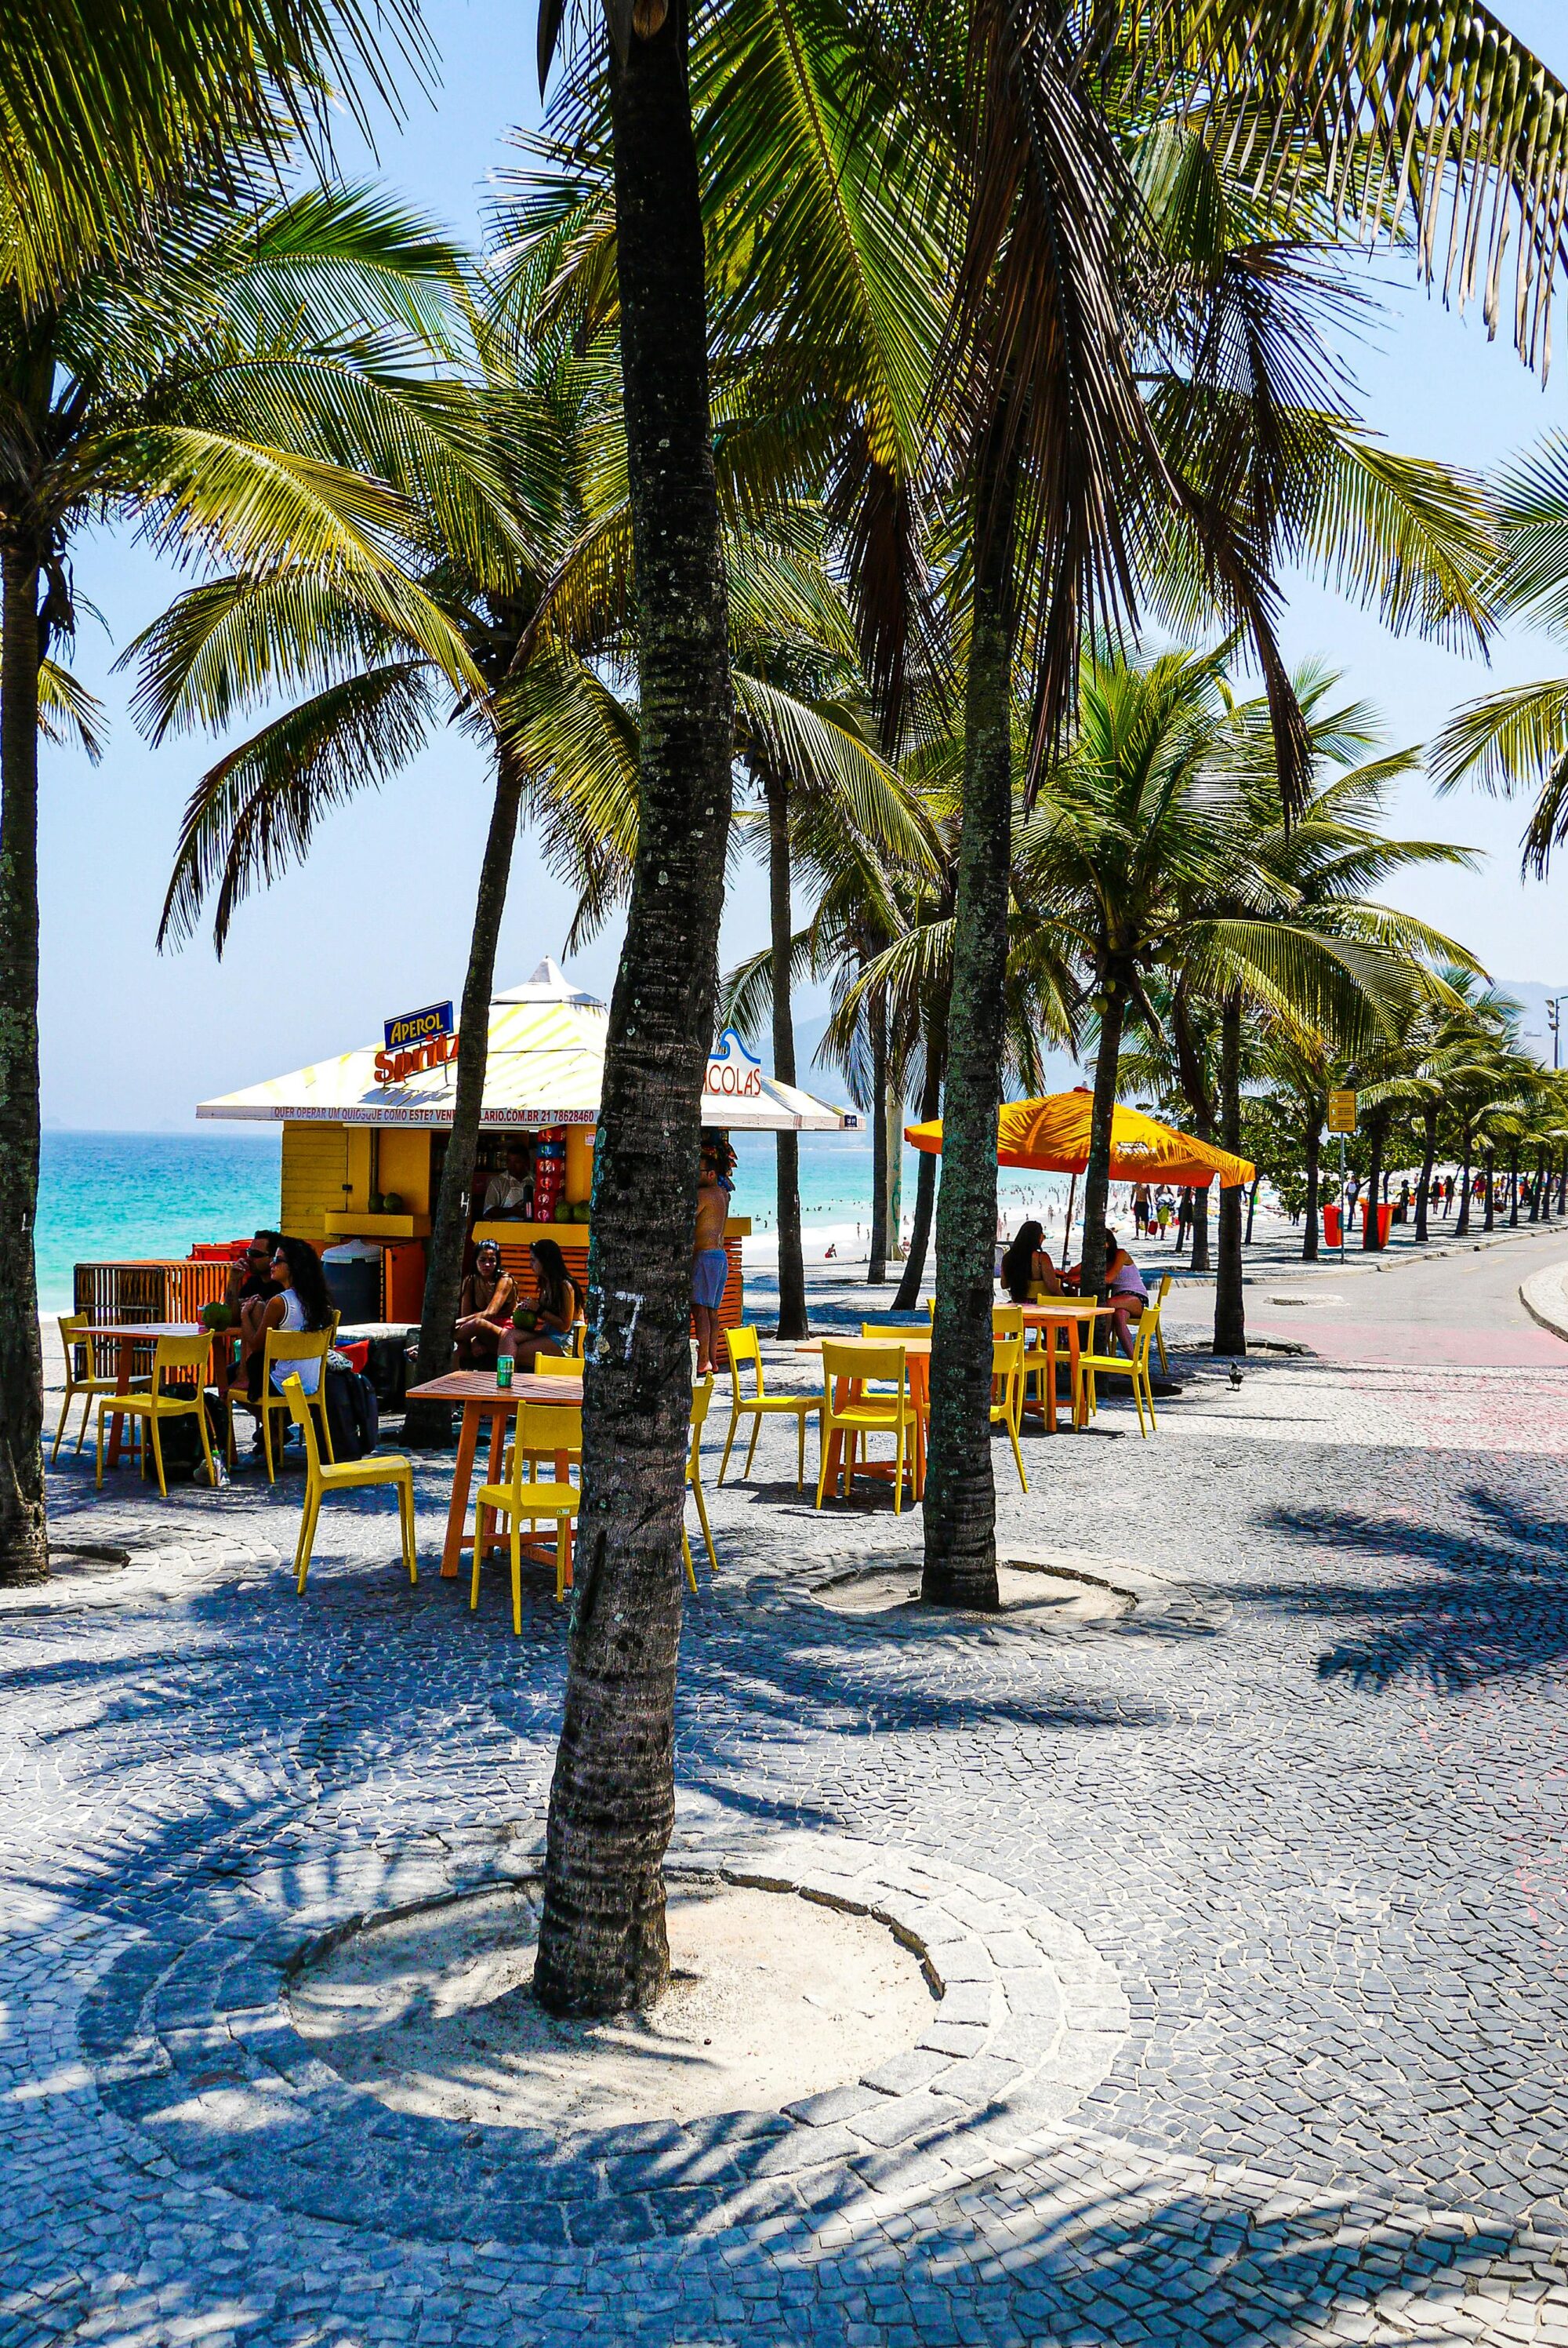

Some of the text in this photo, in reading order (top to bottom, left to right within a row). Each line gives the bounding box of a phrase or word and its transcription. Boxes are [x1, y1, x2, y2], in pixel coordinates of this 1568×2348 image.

[390, 1012, 444, 1044] APEROL
[274, 1107, 295, 1118] QUER
[296, 1107, 327, 1119] OPERAR
[328, 1107, 340, 1119] UM
[384, 1108, 407, 1121] COMO
[409, 1109, 434, 1121] ESTE?
[541, 1110, 550, 1121] 21
[554, 1110, 593, 1122] 78628460
